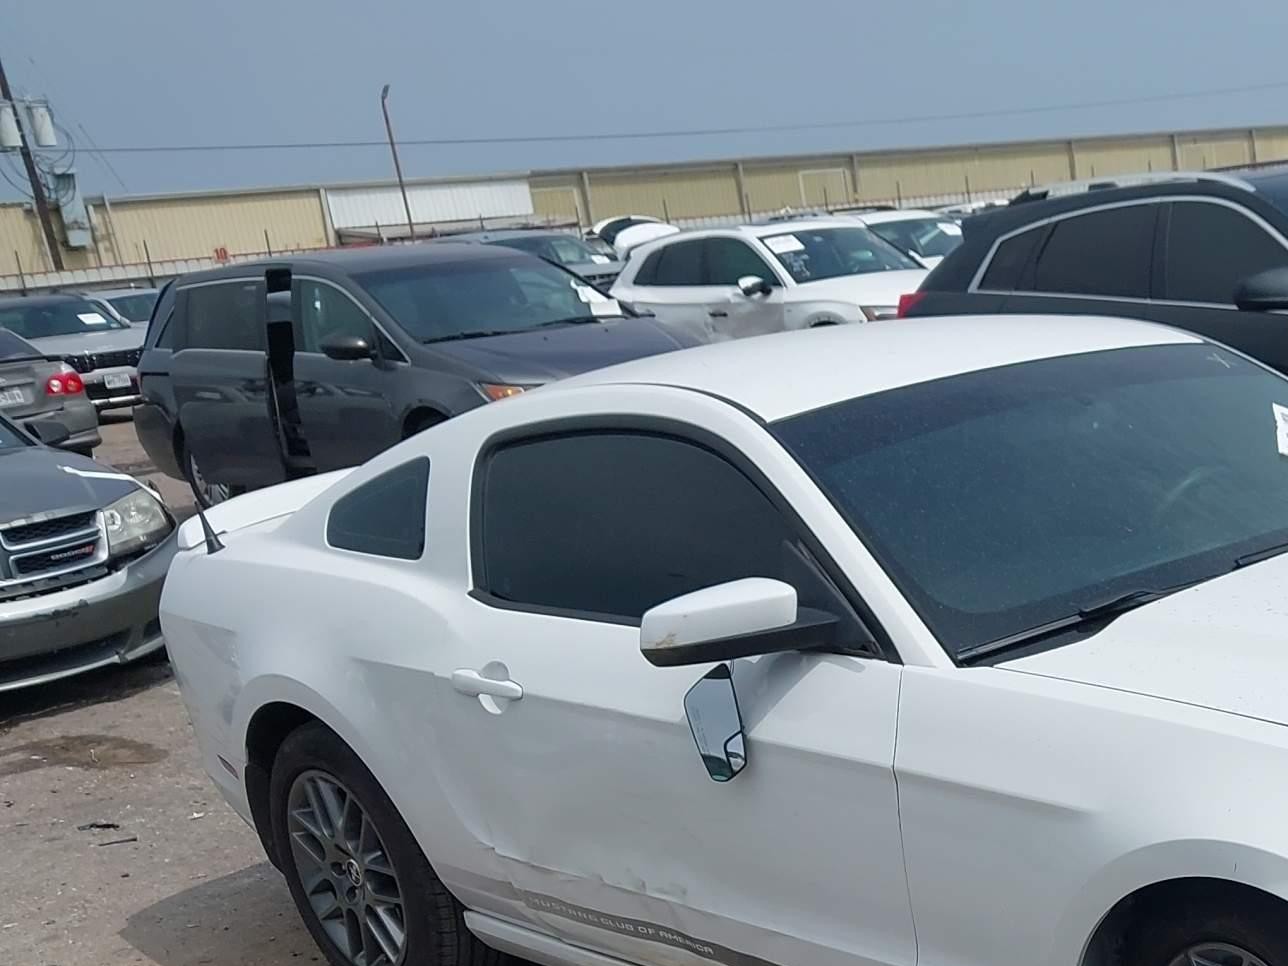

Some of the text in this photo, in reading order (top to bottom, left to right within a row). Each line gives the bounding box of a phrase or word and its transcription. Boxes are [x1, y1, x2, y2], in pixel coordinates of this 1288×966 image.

[600, 917, 634, 931] CLUB
[638, 926, 656, 935] OF
[659, 930, 714, 955] AMERICA
